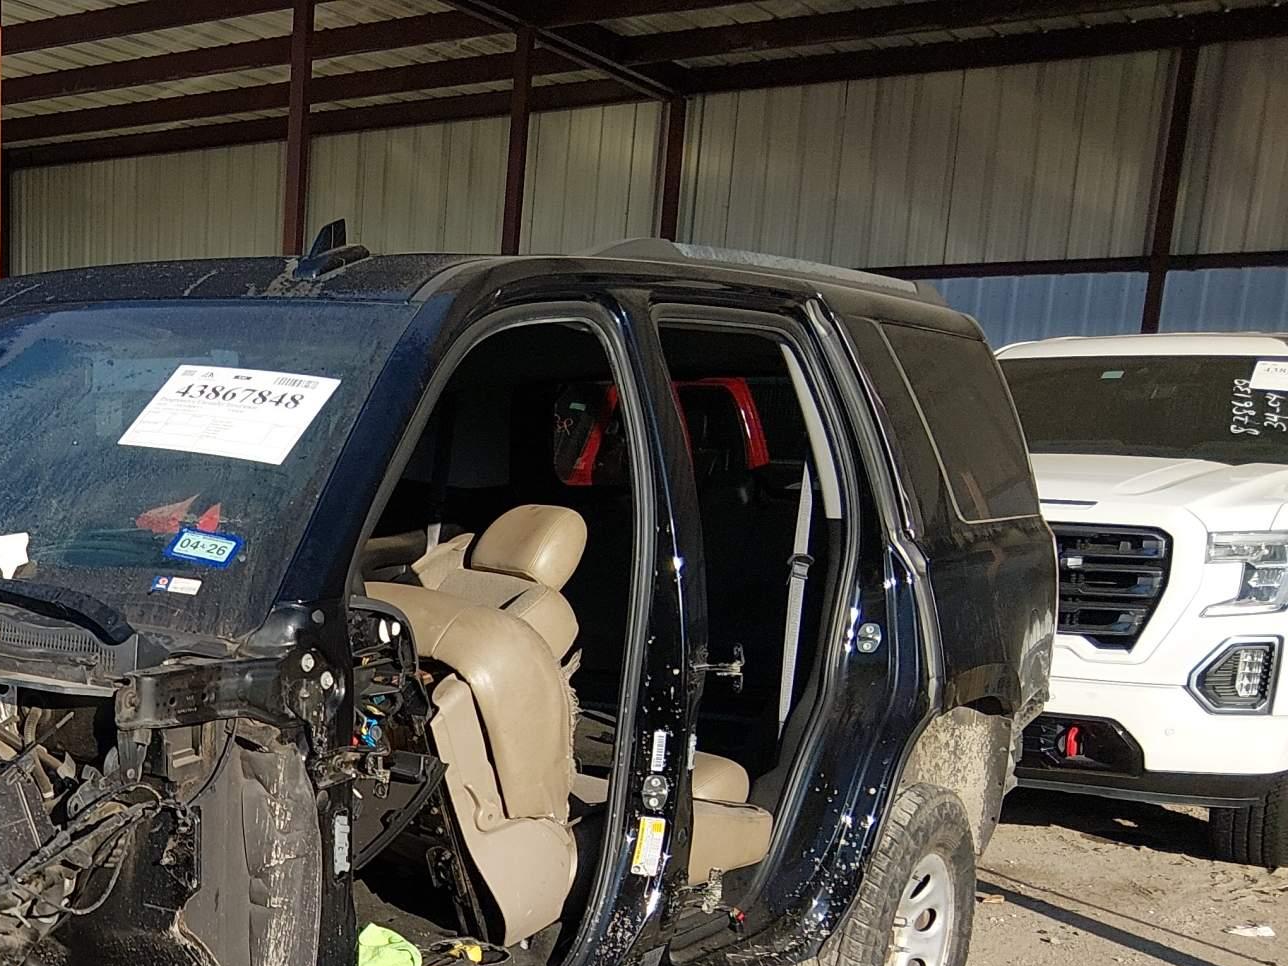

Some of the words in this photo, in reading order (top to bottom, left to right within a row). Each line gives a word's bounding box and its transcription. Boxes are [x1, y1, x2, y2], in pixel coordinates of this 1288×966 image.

[175, 383, 305, 409] 43867848
[179, 538, 201, 550] 04
[206, 543, 228, 556] 26
